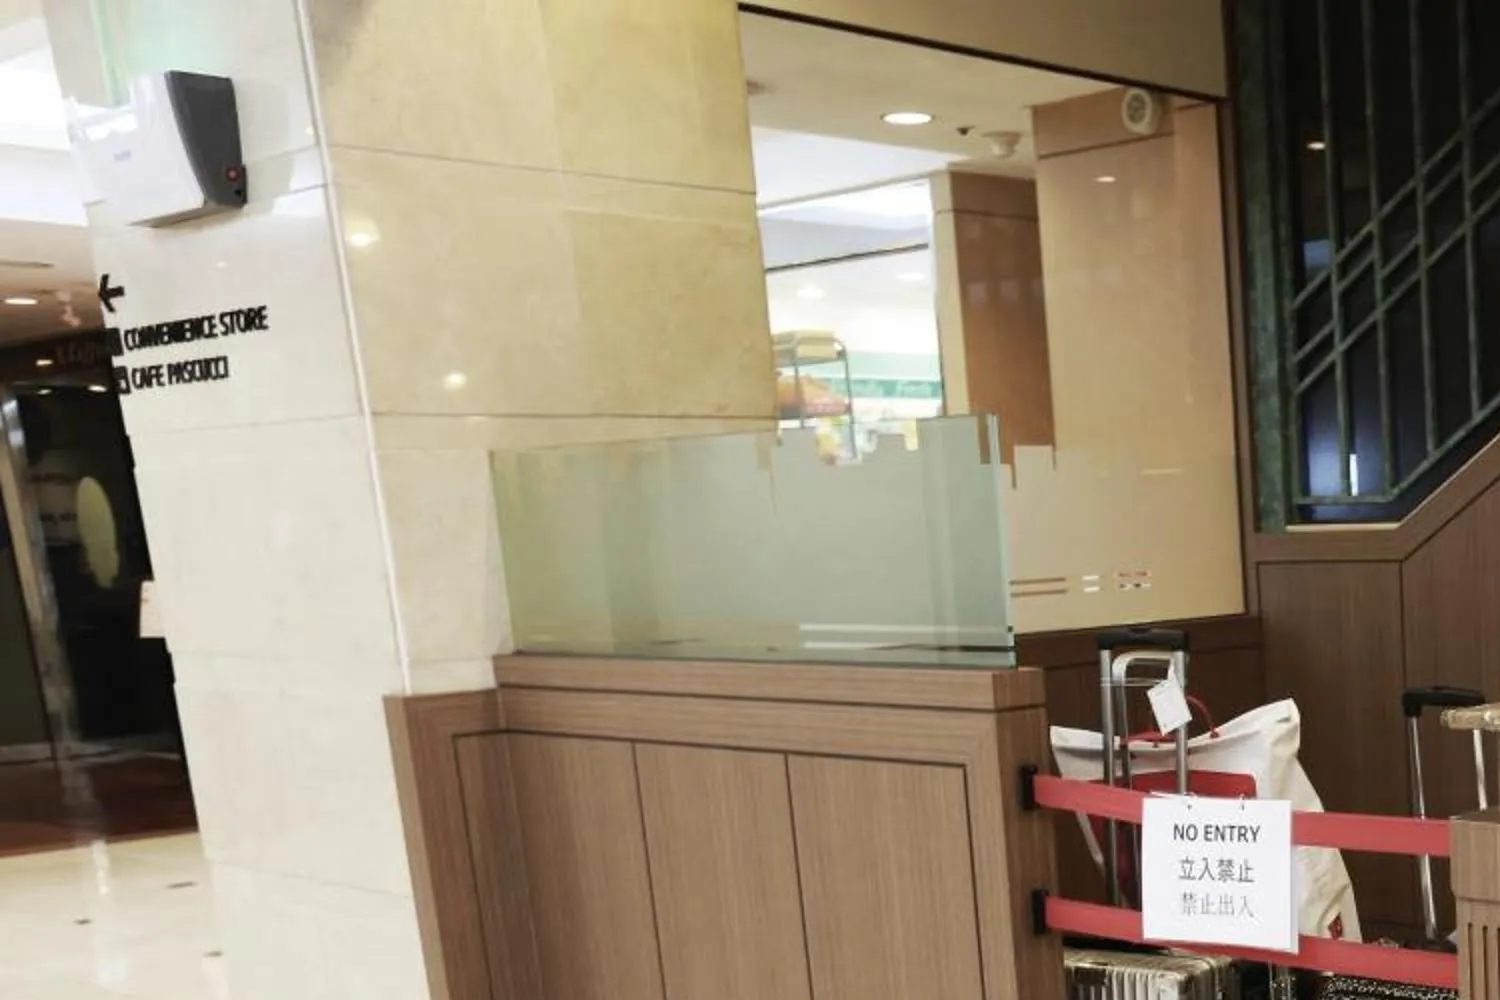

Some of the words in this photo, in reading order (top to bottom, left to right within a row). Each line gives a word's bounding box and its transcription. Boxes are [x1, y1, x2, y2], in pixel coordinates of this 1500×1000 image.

[123, 314, 219, 351] CONVENIENCE
[219, 304, 269, 336] STORE
[131, 364, 166, 389] CAFE
[167, 355, 230, 385] PASCUCCI
[1173, 824, 1199, 841] NO
[1203, 824, 1261, 843] ENTRY
[1178, 856, 1255, 883] 立入禁止
